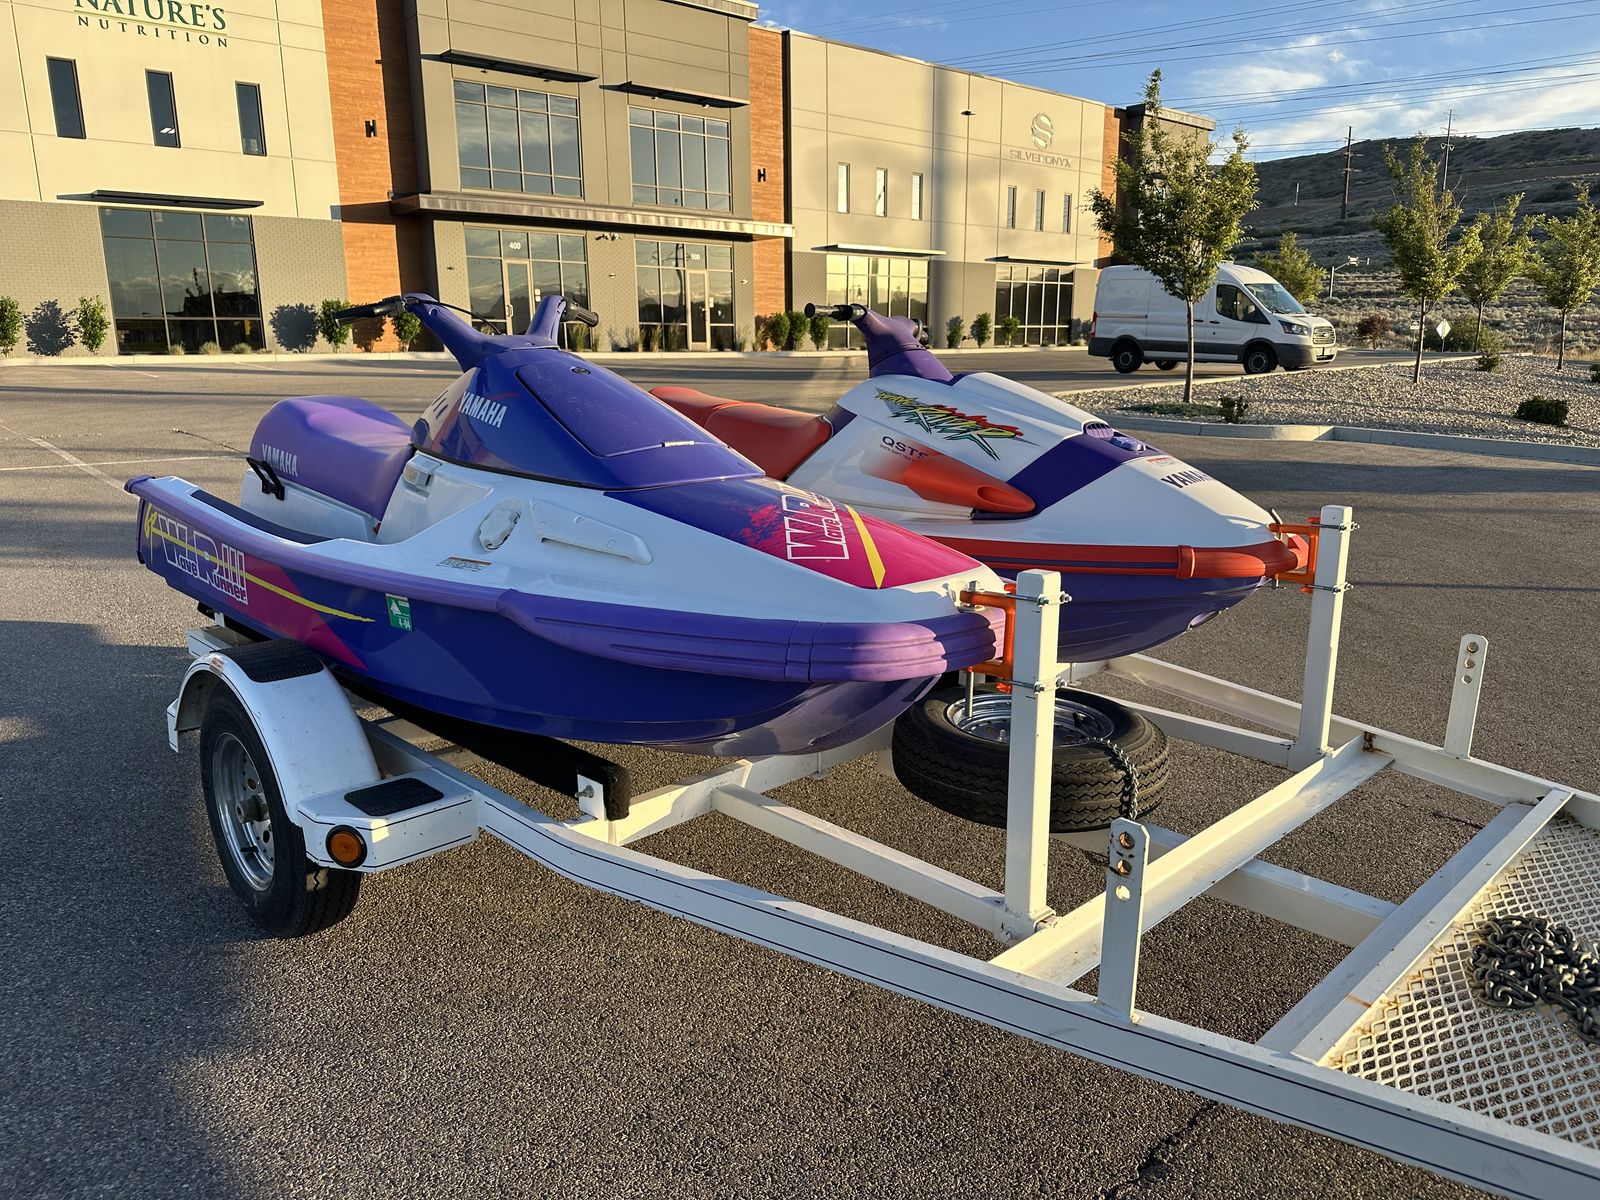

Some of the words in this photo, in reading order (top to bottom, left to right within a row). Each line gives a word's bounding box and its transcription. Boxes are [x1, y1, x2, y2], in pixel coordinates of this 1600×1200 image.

[78, 15, 228, 48] NUTRITION
[509, 241, 522, 250] 400
[458, 391, 508, 428] YAMAHA
[261, 443, 299, 477] YAMAHA
[1160, 469, 1212, 488] YAMA
